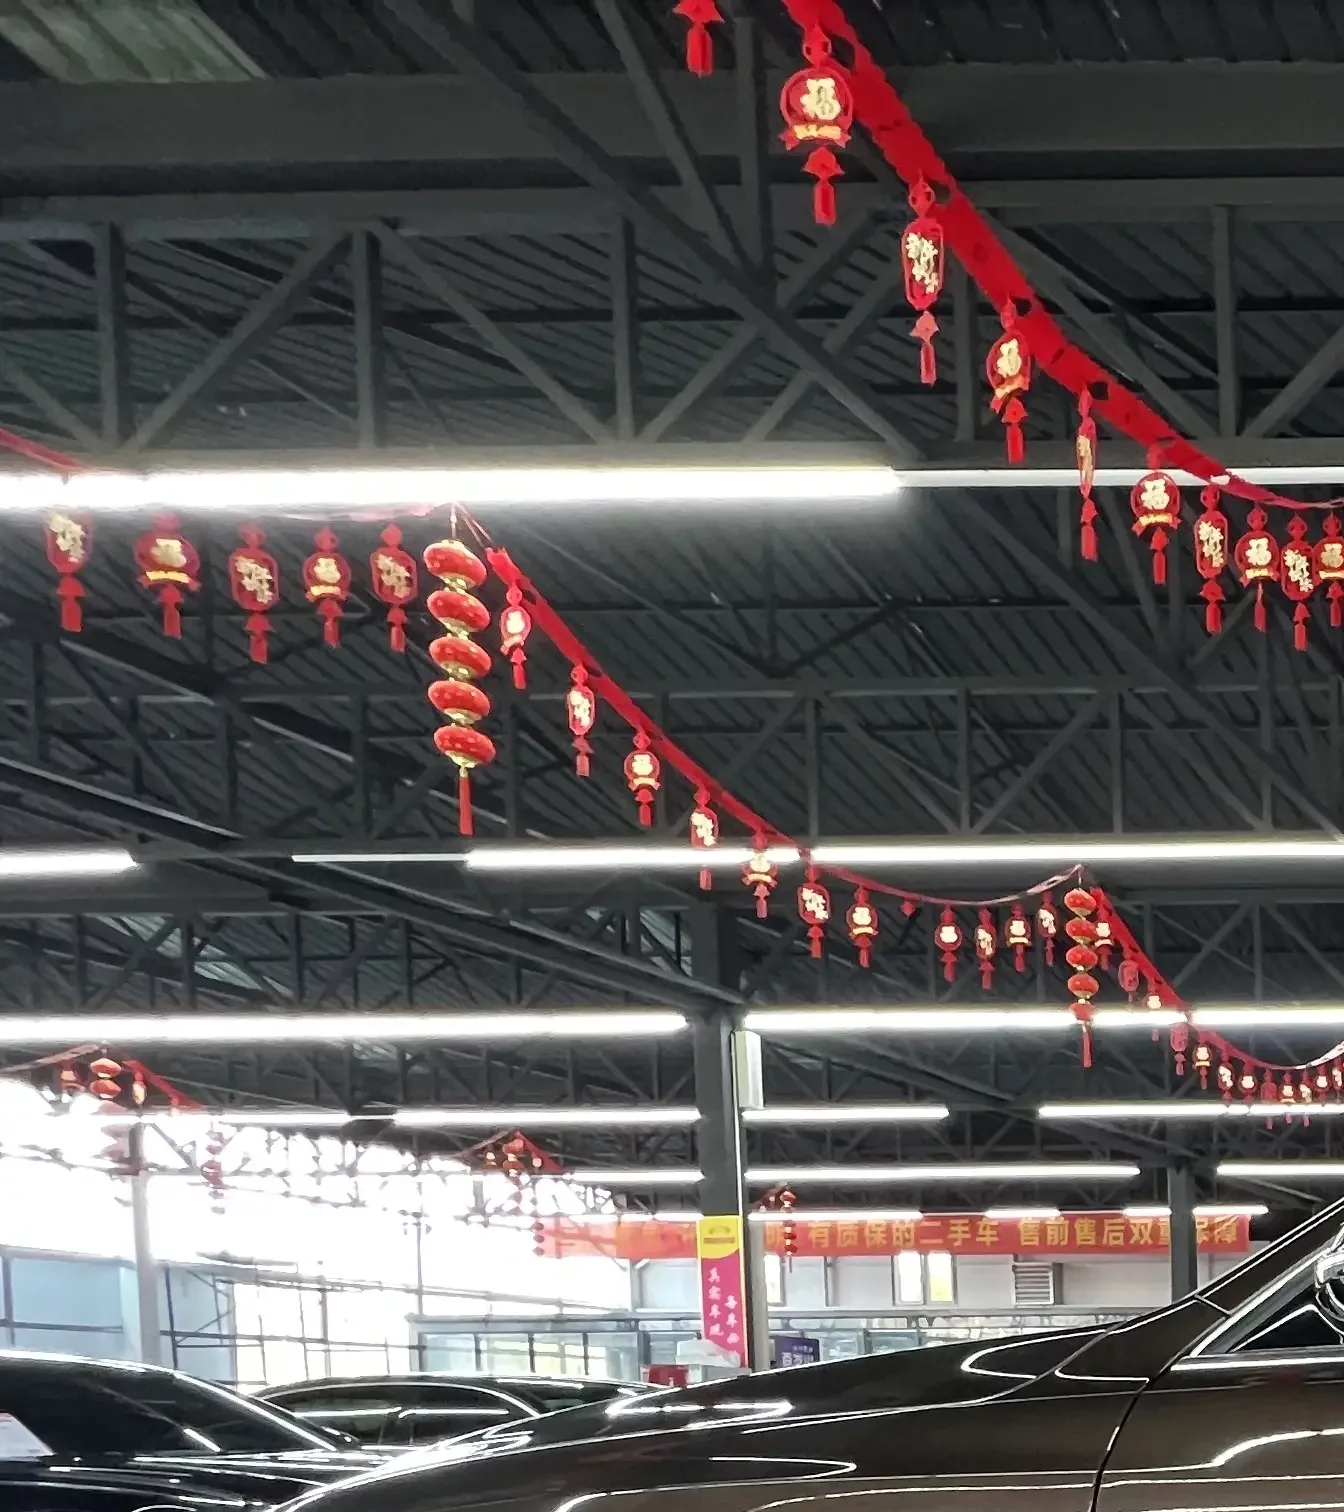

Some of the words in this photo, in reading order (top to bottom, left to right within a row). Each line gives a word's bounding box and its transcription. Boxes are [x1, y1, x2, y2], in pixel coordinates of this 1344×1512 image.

[808, 1217, 1000, 1248] 有质保的二手车
